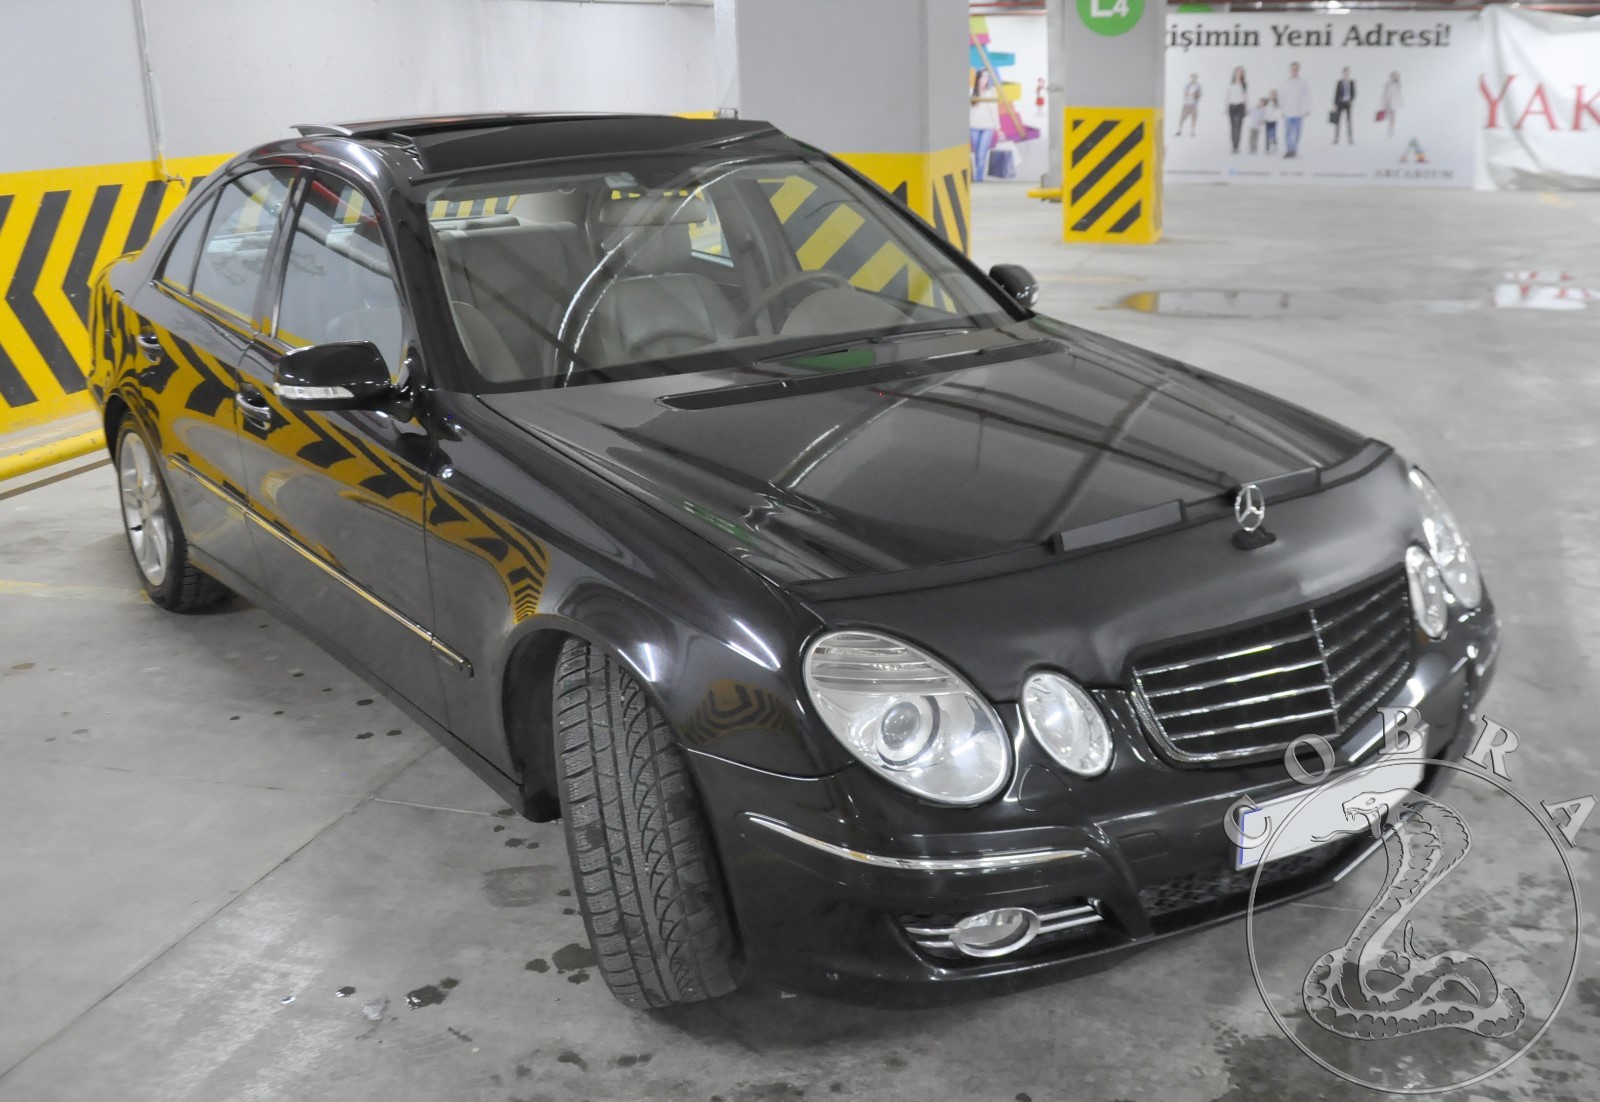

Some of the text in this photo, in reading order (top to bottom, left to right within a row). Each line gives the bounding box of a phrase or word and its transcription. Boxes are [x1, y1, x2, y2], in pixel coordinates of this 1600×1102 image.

[1166, 23, 1451, 52] işimin Yeni Adresi!
